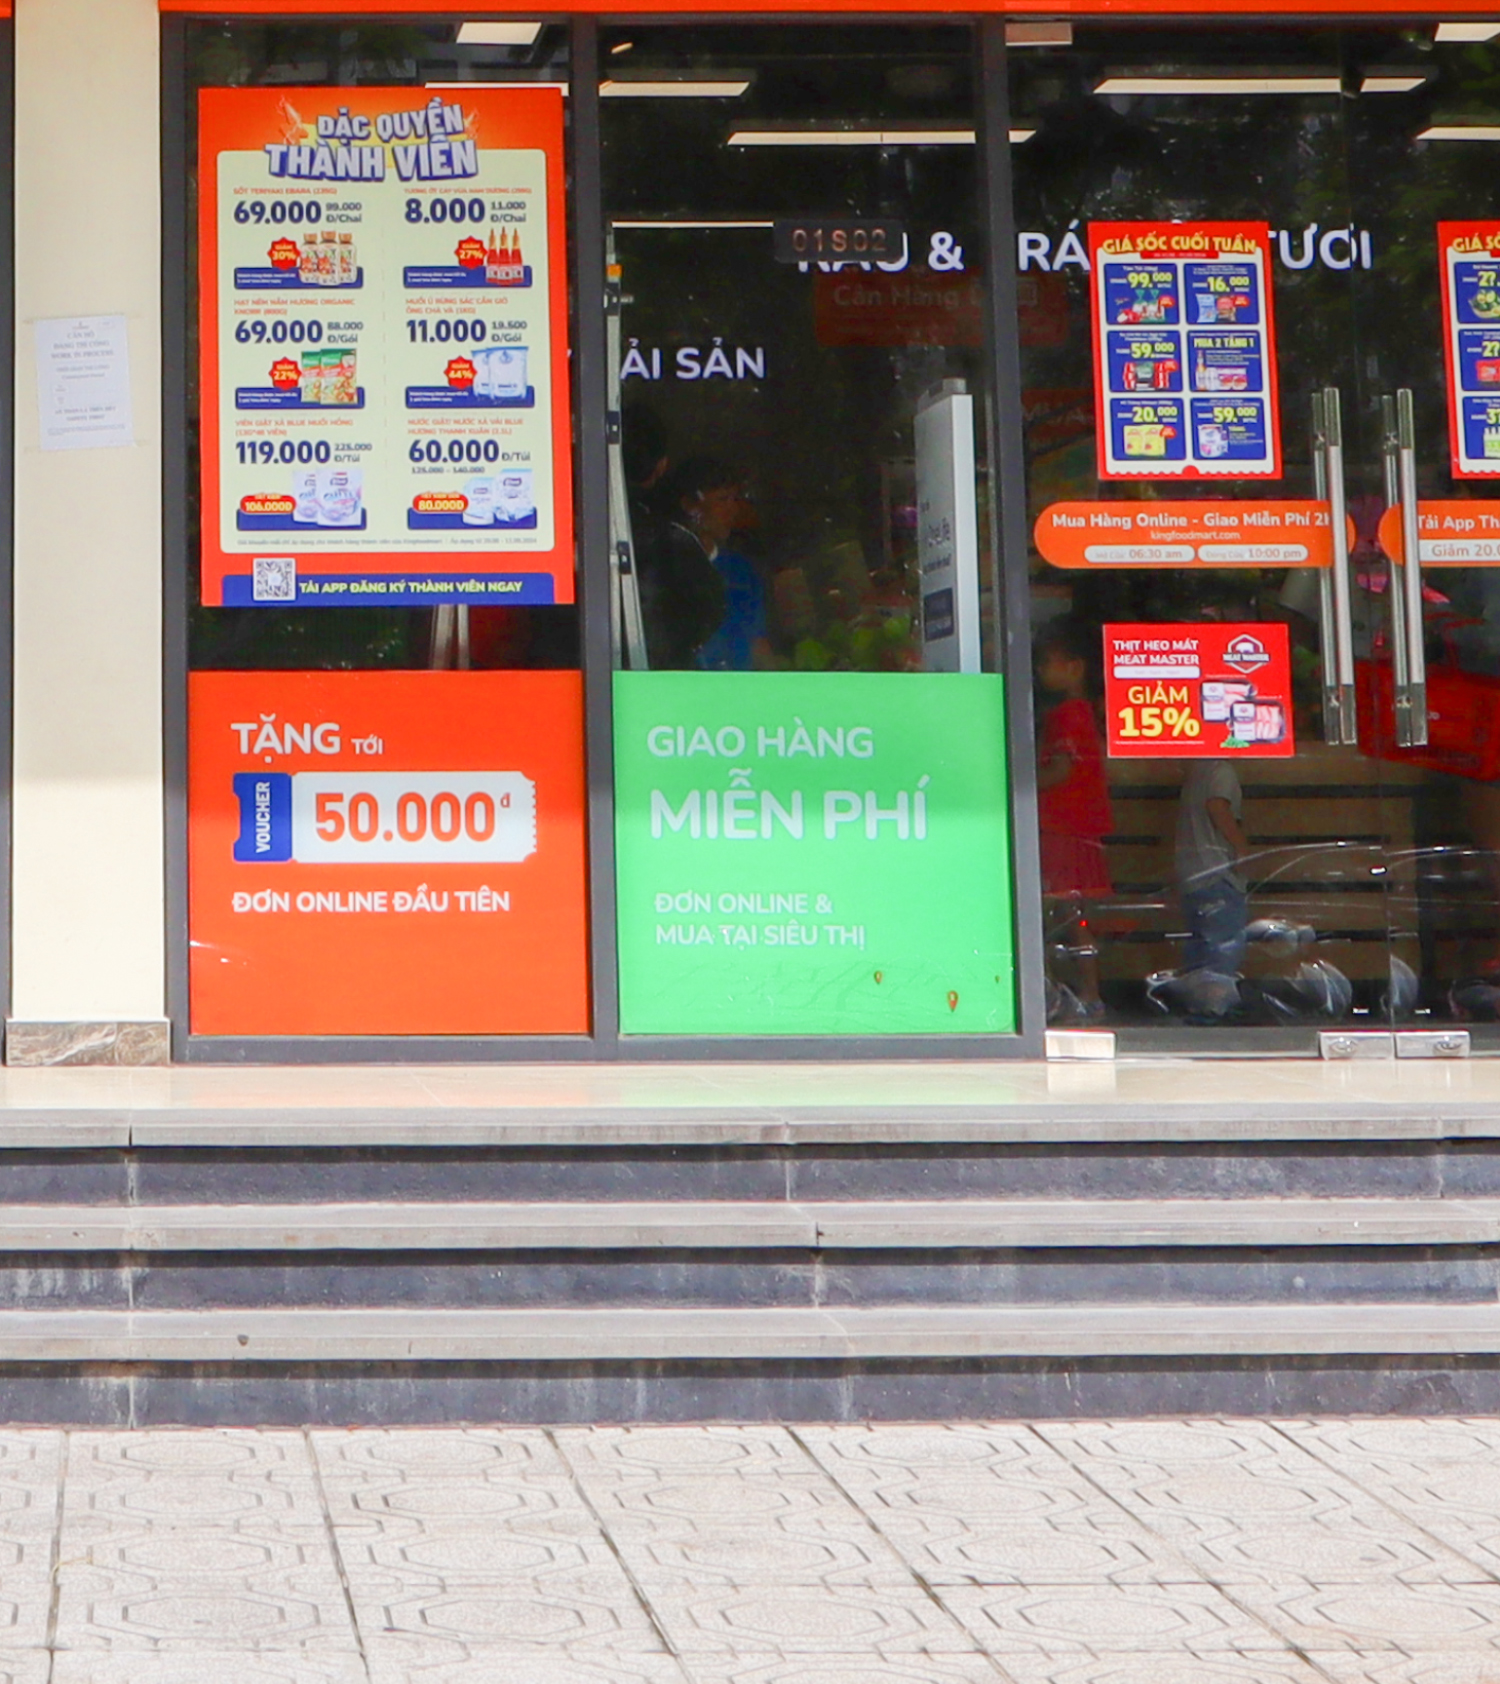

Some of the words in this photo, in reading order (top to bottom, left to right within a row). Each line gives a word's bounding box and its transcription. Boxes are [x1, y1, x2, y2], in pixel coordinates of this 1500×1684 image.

[317, 107, 370, 143] ĐẶC
[376, 97, 466, 142] QUYỀN
[264, 138, 385, 181] THÀNH
[394, 136, 478, 181] VIÊN
[234, 201, 321, 224] 69.000
[405, 198, 485, 223] 8.000
[792, 229, 887, 253] 01S02
[928, 232, 964, 271] &
[1268, 223, 1372, 269] ƯƠI
[1103, 235, 1133, 254] GIÁ
[1136, 231, 1167, 251] SỐC
[1171, 231, 1209, 250] CUỐI
[1212, 233, 1256, 253] TUẦN
[1453, 233, 1482, 252] GIÁ
[235, 320, 323, 343] 69.000
[407, 319, 486, 342] 11.000
[620, 338, 661, 379] ẢI
[676, 337, 766, 379] SẢN
[236, 440, 331, 464] 119.000
[409, 439, 499, 463] 60.000
[1052, 513, 1085, 527] Mua
[1090, 512, 1132, 529] Hàng
[1136, 512, 1188, 527] Online
[1203, 513, 1239, 526] Giao
[1243, 511, 1280, 526] Miễn
[1284, 511, 1310, 526] Phí
[1418, 514, 1438, 530] Tải
[1443, 516, 1475, 532] App
[1150, 530, 1240, 542] kingfoodmart.com
[1431, 542, 1470, 556] Giảm
[299, 579, 320, 593] TẢI
[321, 583, 347, 593] APP
[350, 580, 387, 593] ĐĂNG
[389, 580, 406, 593] KÝ
[408, 579, 454, 593] THÀNH
[456, 579, 485, 592] VIÊN
[487, 581, 523, 592] NGAY
[1113, 640, 1141, 653] THỊT
[1144, 640, 1170, 651] HEO
[1173, 637, 1199, 651] MÁT
[1113, 654, 1147, 665] MEAT
[1150, 654, 1199, 665] MASTER
[1128, 681, 1189, 704] GIẢM
[1118, 707, 1200, 737] 15%
[230, 713, 340, 764] TẶNG
[351, 735, 383, 755] TỚI
[646, 724, 745, 760] GIAO
[756, 717, 874, 760] HÀNG
[649, 768, 801, 842] MIỄN
[822, 775, 929, 841] PHÍ
[255, 781, 271, 854] VOUCHER
[232, 888, 289, 913] ĐƠN
[296, 889, 389, 913] ONLINE
[393, 883, 448, 913] ĐẦU
[455, 884, 510, 913] TIÊN
[654, 891, 711, 915] ĐƠN
[717, 893, 808, 915] ONLINE
[814, 893, 833, 915] &
[655, 924, 713, 946] MUA
[718, 924, 759, 950] TẠI
[764, 920, 817, 946] SIÊU
[822, 924, 866, 950] THỊ
